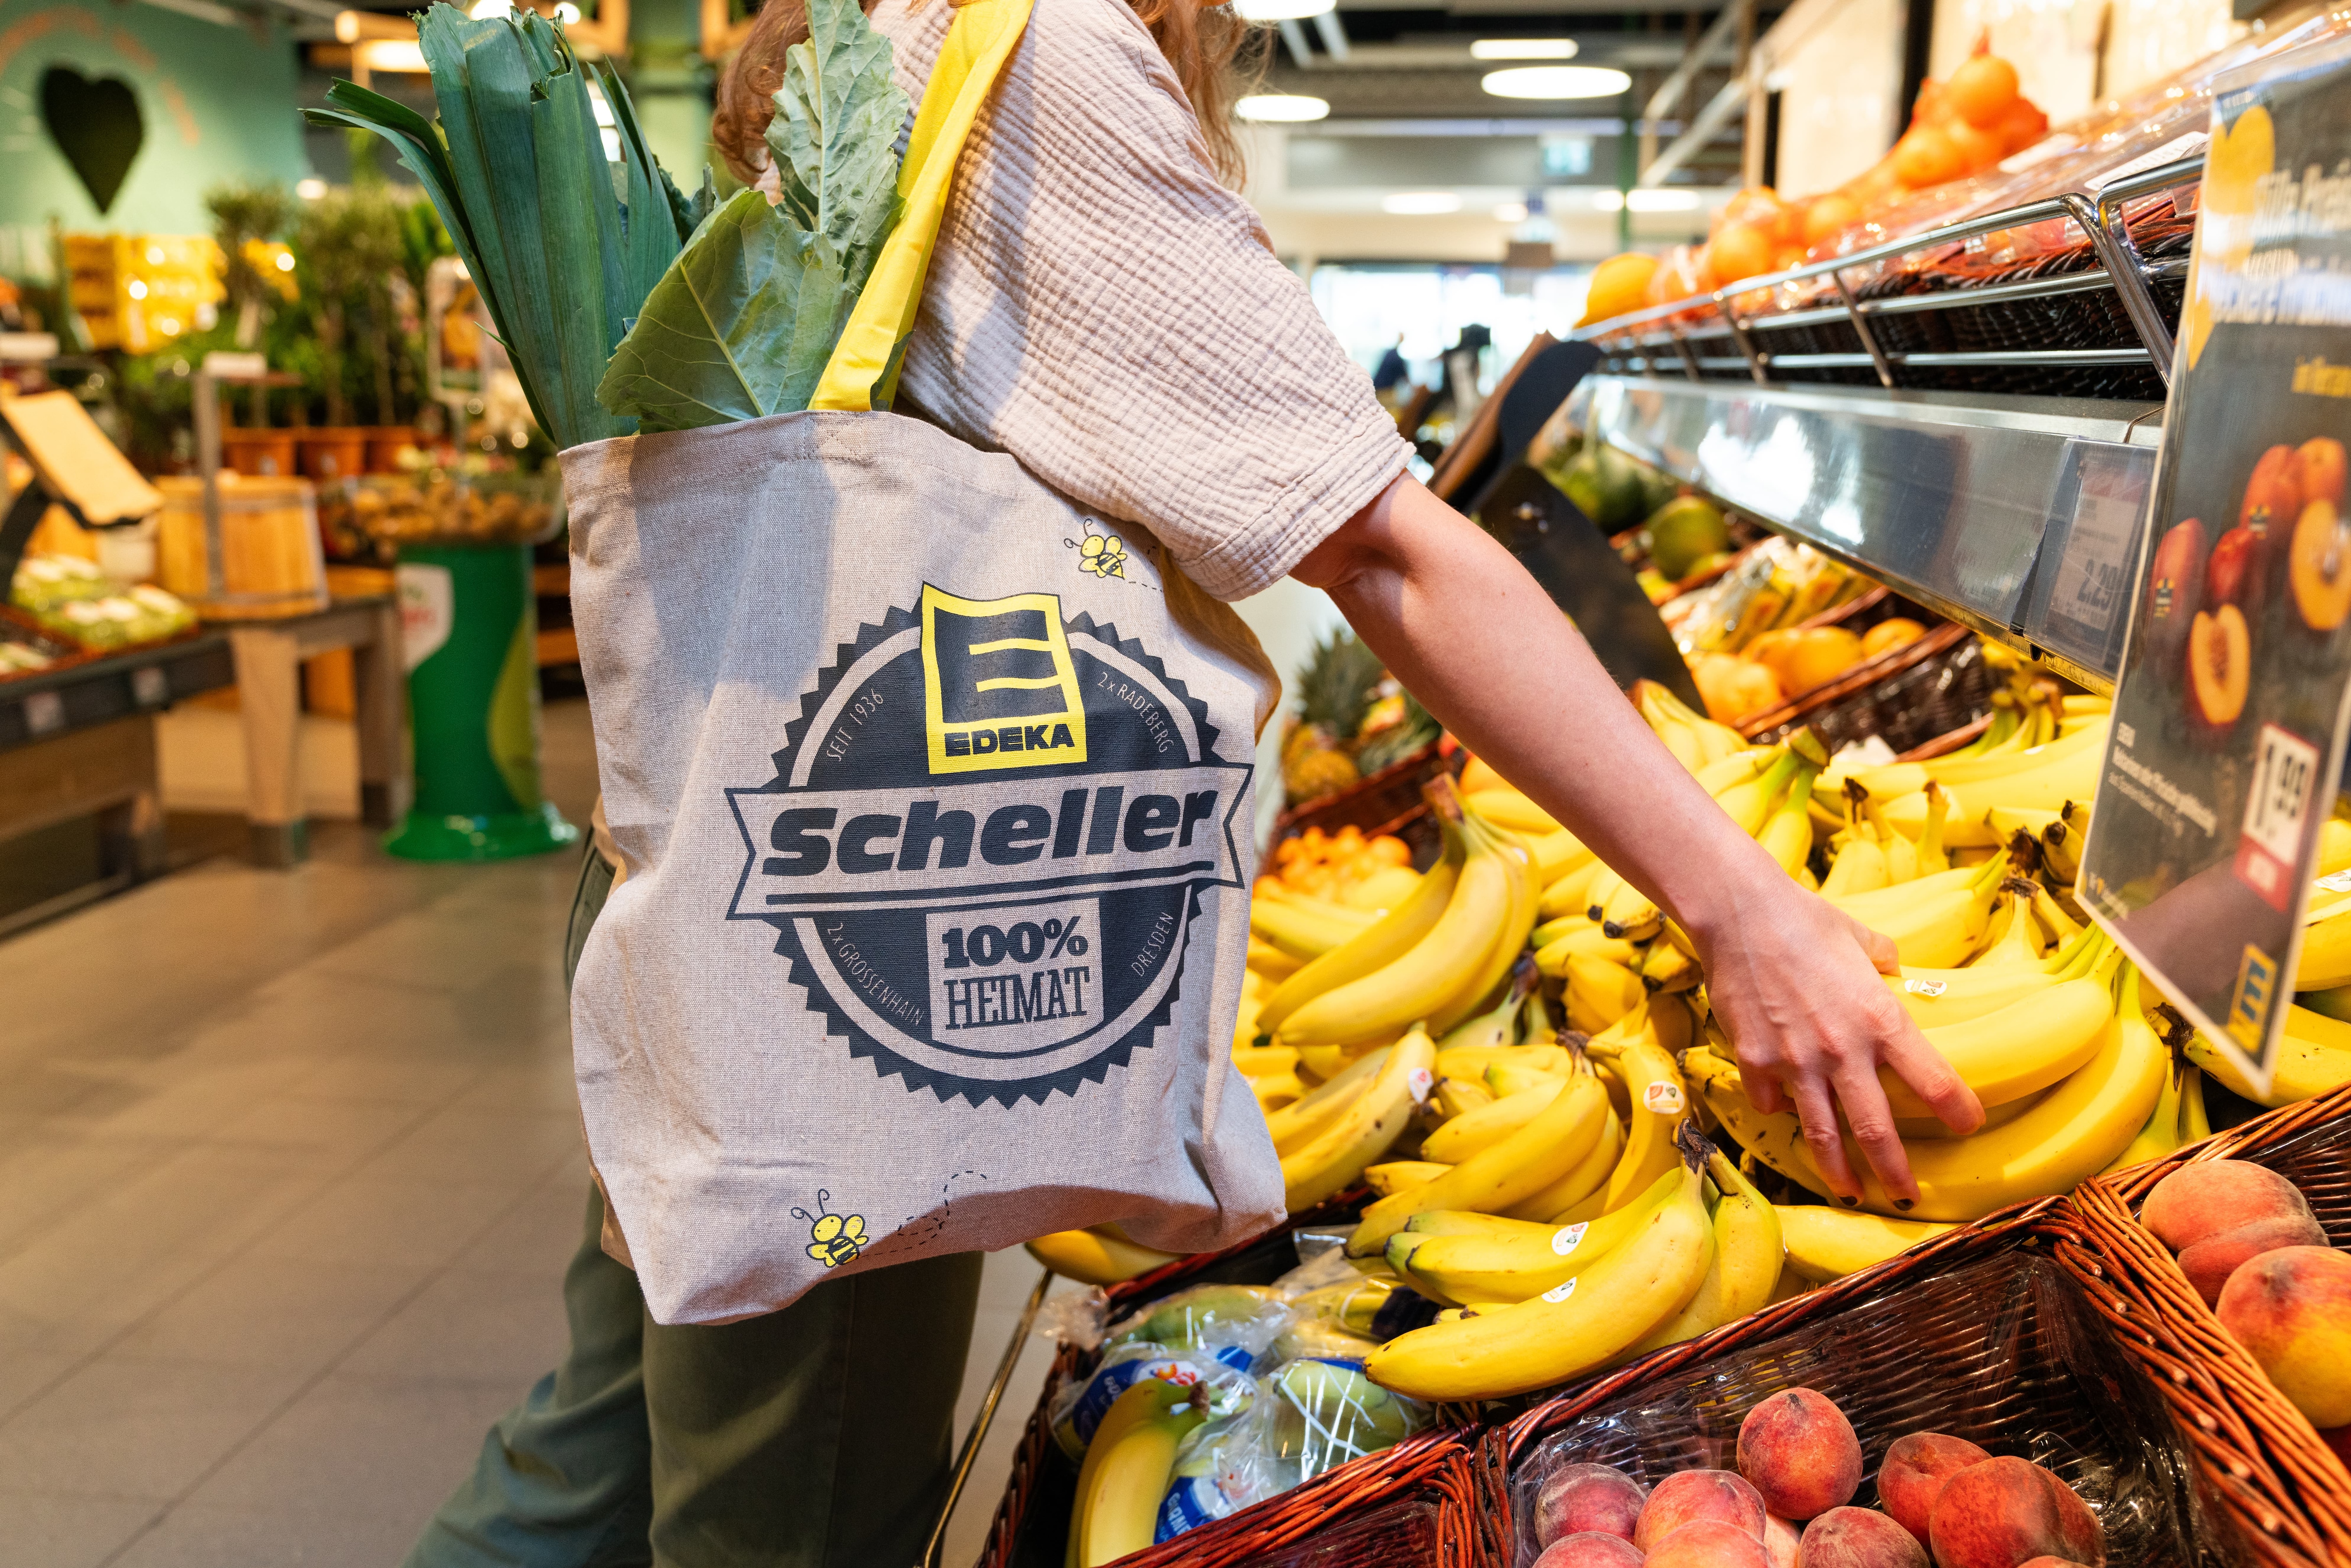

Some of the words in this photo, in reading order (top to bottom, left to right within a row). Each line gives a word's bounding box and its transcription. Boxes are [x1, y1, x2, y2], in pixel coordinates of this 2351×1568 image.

[826, 726, 852, 762] SEIT
[849, 687, 884, 725] 1936
[944, 723, 1075, 757] EDEKA
[1117, 683, 1175, 753] RADEBERG
[761, 785, 1218, 877] scheller
[941, 915, 1089, 969] 100%
[1131, 911, 1174, 977] DRESDEN
[838, 943, 925, 1027] GROSSENHAIN
[943, 966, 1090, 1030] HEIMAT
